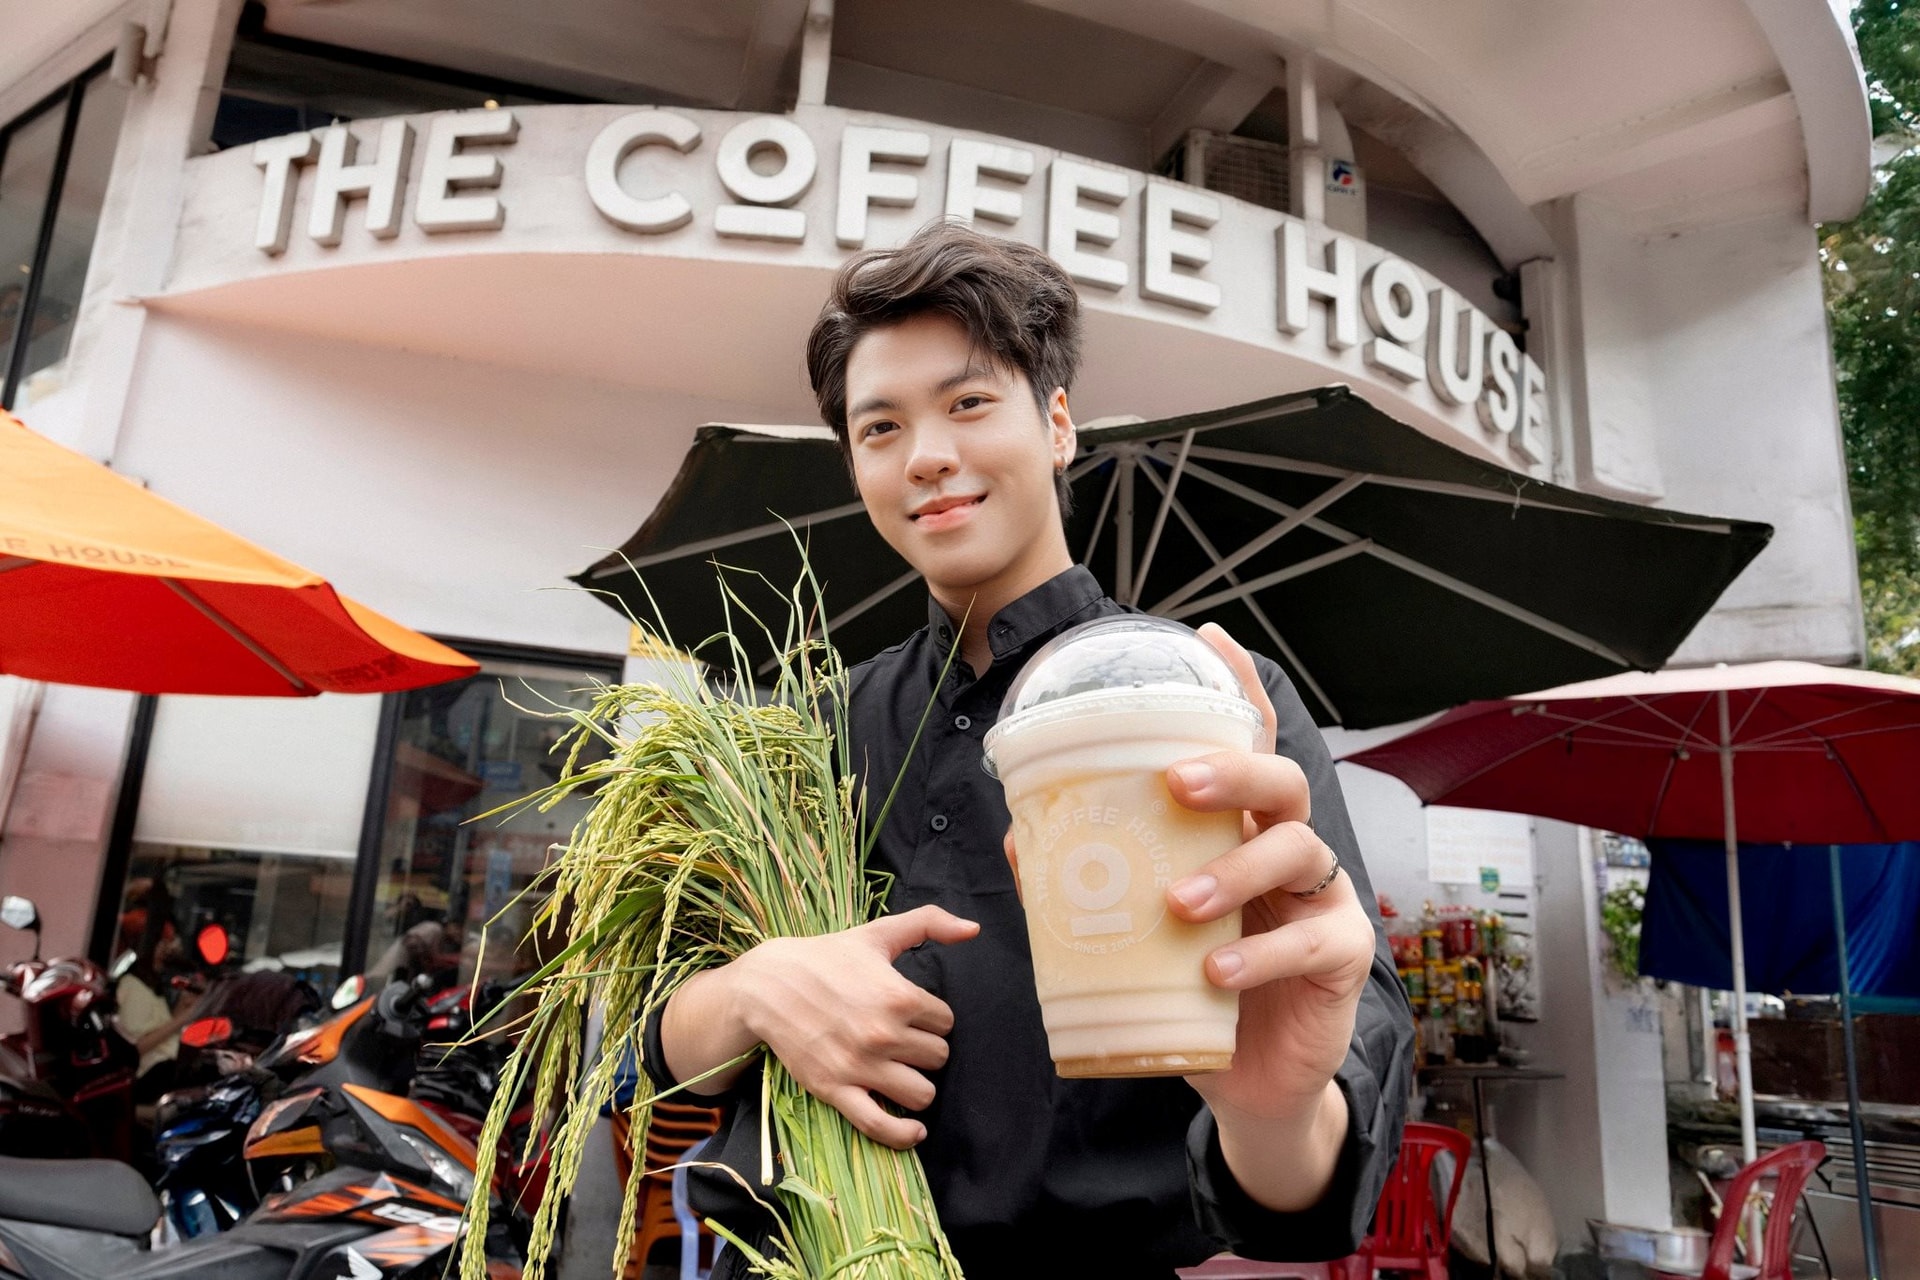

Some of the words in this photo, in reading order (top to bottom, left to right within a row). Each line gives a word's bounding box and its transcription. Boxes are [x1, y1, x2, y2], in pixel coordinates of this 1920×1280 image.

[253, 110, 519, 256] THE
[585, 109, 1221, 312] COFFEE
[1275, 220, 1545, 465] HOUSE
[1041, 805, 1120, 853] COFFEE
[1126, 815, 1172, 889] HOUSE
[1072, 941, 1108, 955] SINCE
